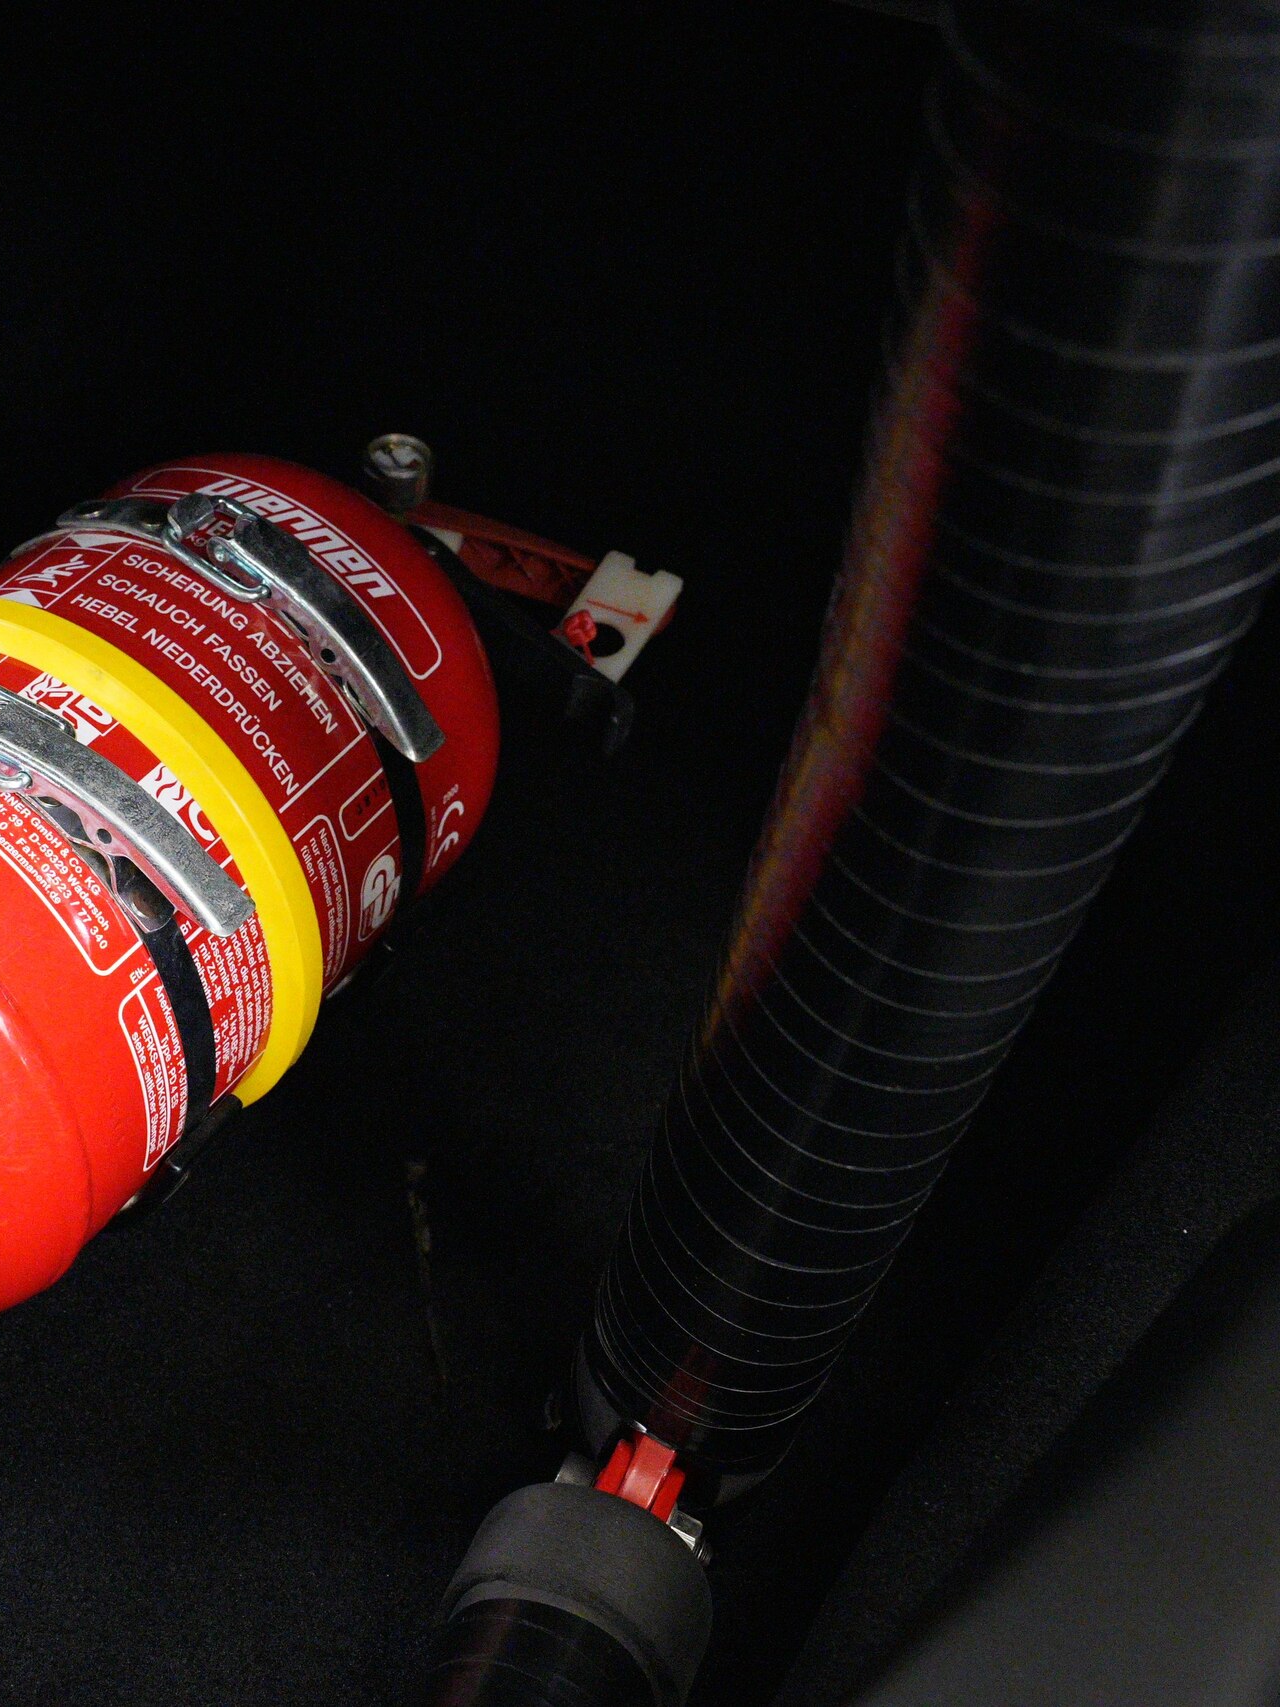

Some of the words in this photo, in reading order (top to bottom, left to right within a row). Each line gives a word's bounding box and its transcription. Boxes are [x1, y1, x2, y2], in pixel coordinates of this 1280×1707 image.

[97, 573, 206, 638] SCHAUCH
[203, 632, 283, 713] FASSEN
[123, 554, 250, 632] SICHERUNG
[246, 630, 339, 736] ABZIEHEN
[70, 593, 138, 634] HEBEL
[142, 628, 300, 797] NIEDERDRÜCKEN
[30, 816, 63, 853] GmbH
[60, 848, 70, 858] &
[69, 857, 84, 878] Co.
[84, 876, 102, 896] KG
[301, 844, 314, 879] füllen
[309, 837, 320, 858] nur
[318, 827, 333, 860] Nach
[0, 821, 8, 831] 0
[15, 836, 41, 863] Fax:
[40, 862, 72, 900] 02523
[77, 907, 92, 924] 77
[89, 926, 108, 949] 340
[8, 813, 24, 829] 39
[28, 832, 70, 877] D-59329
[67, 873, 110, 931] Wadersloh
[198, 943, 212, 963] mit
[207, 934, 233, 998] Löschmittel
[240, 966, 249, 983] die
[255, 942, 265, 963] Nur
[244, 983, 253, 1002] mit
[251, 968, 260, 990] und
[154, 985, 181, 1056] Anerkennung
[131, 1031, 146, 1064] siehe
[161, 1033, 172, 1062] Type
[169, 1066, 177, 1085] PD
[138, 1014, 167, 1151] WERKS-ENDKONTROLLE
